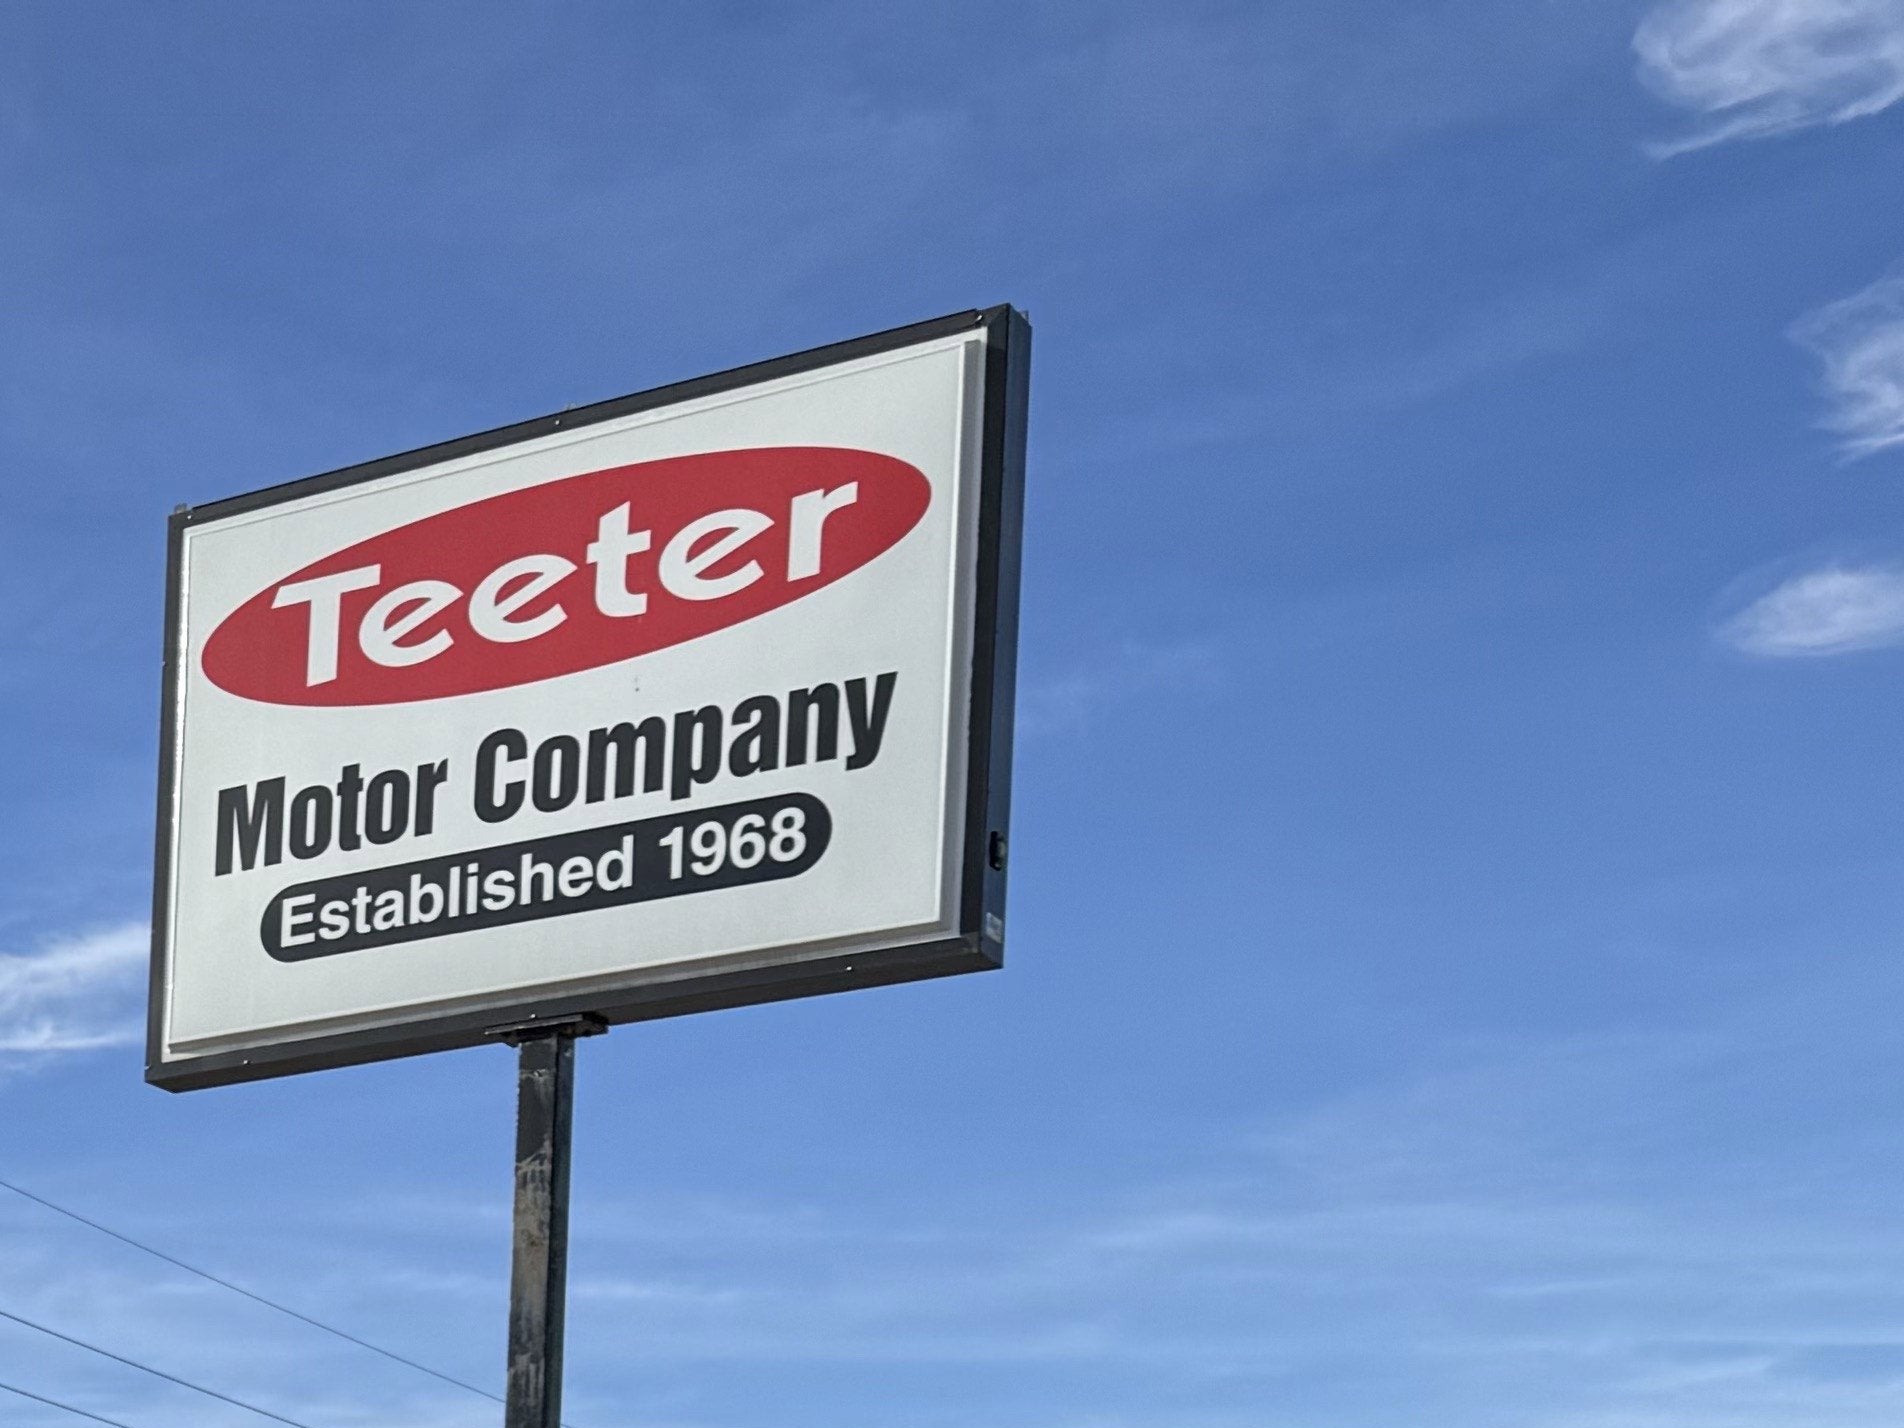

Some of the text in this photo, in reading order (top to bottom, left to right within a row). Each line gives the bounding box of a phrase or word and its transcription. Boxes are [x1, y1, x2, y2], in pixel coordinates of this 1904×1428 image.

[270, 480, 859, 687] Teeter
[214, 670, 898, 878] Motor Company
[278, 806, 808, 948] Established 1968
